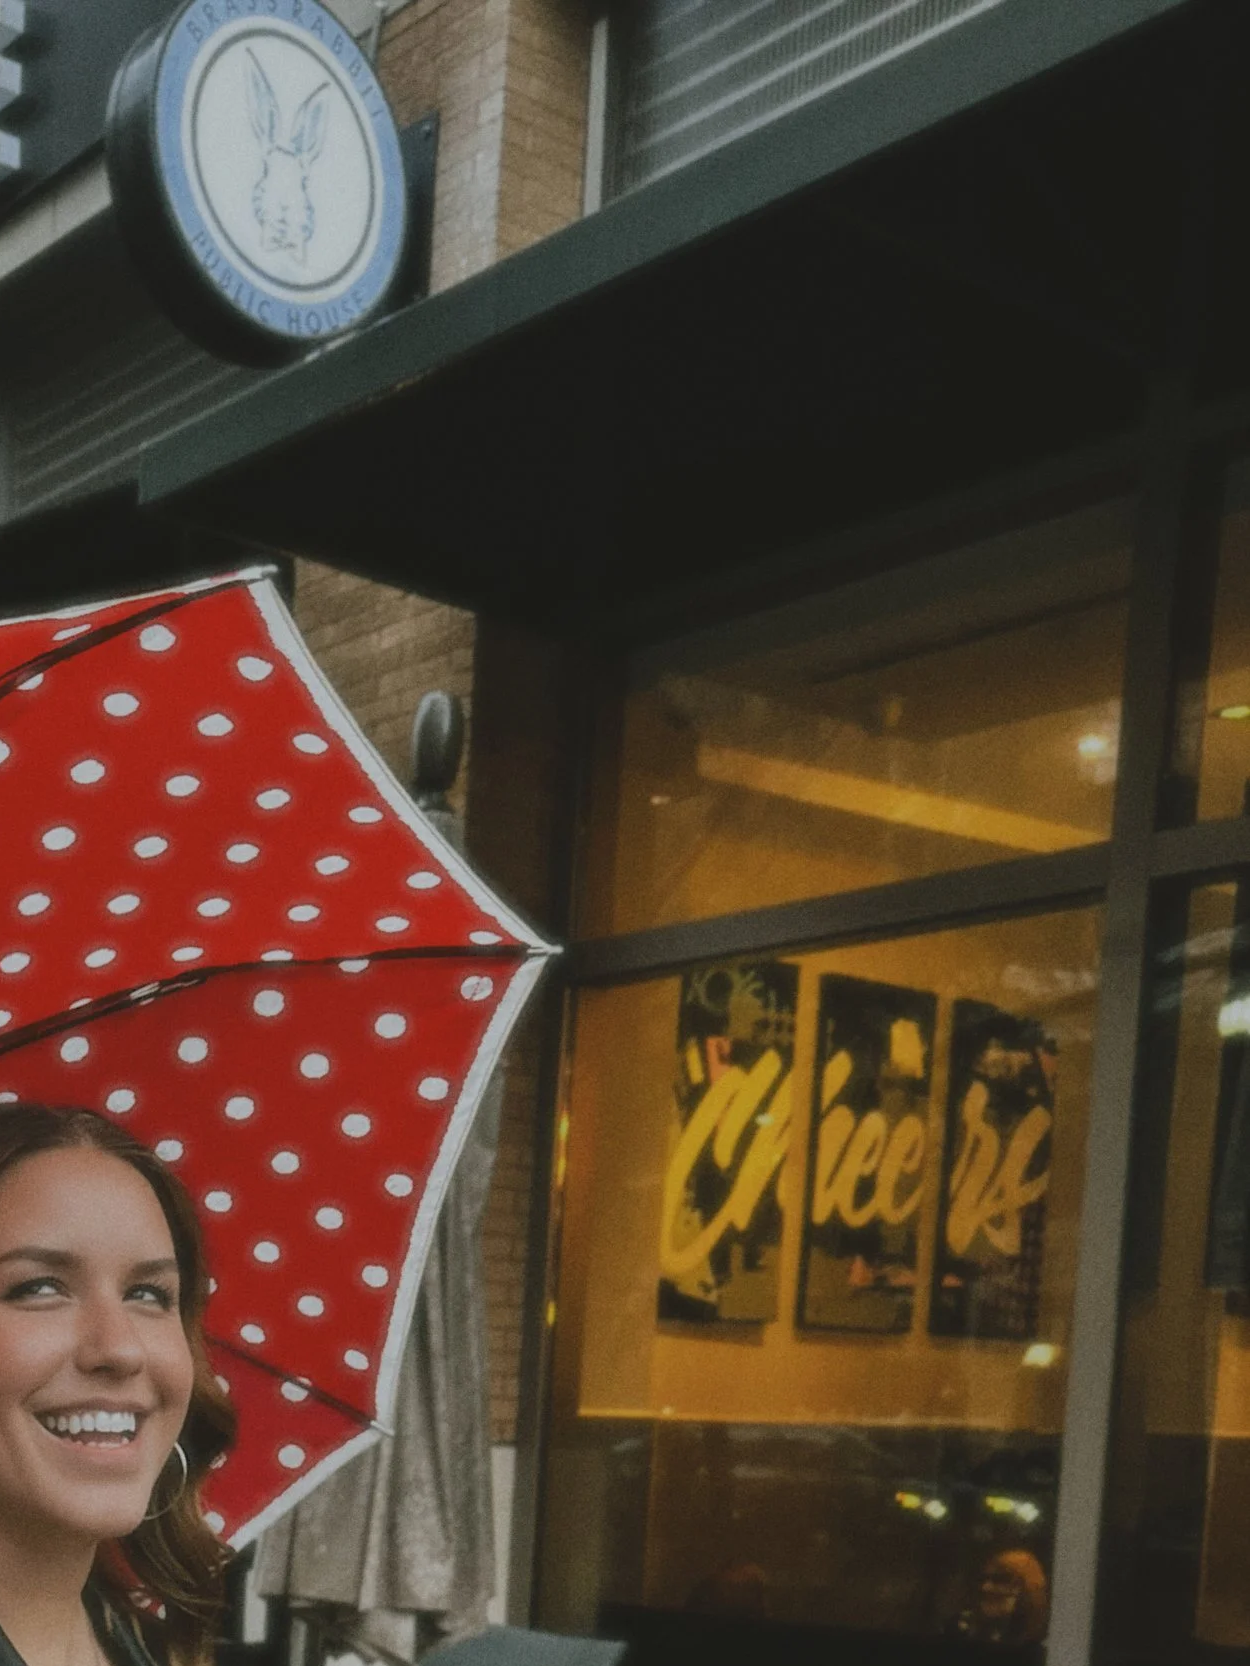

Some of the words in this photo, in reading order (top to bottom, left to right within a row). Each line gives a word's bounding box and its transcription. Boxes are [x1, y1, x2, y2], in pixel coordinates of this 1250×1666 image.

[291, 0, 384, 119] RABBIT
[192, 230, 271, 323] PUBLIC
[286, 289, 364, 334] HOUSE
[659, 1048, 1050, 1273] Cheers
